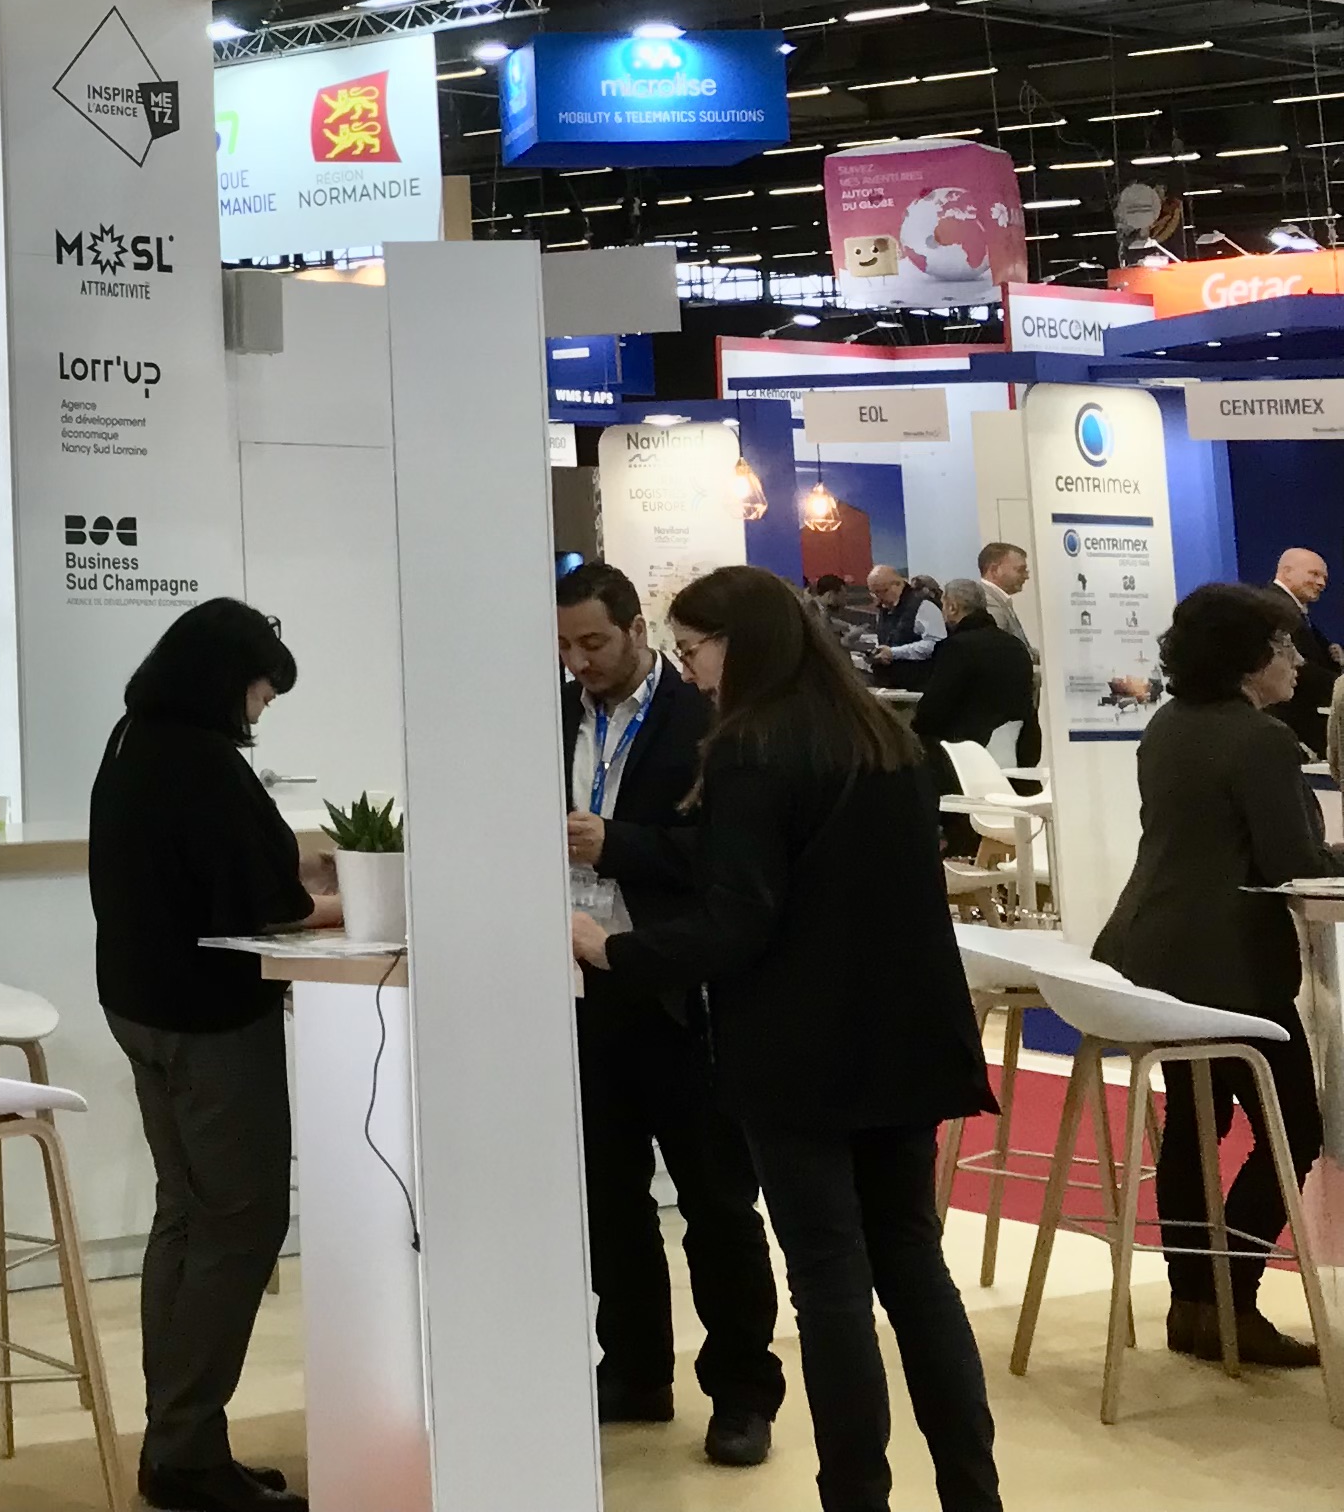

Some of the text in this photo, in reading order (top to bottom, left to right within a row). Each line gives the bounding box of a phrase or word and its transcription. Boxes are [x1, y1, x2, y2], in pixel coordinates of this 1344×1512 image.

[601, 72, 717, 97] microlise
[87, 84, 144, 105] INSPIRE
[87, 102, 138, 118] L'AGENCE
[559, 110, 764, 124] MOBILITY TELEMATICS SOLUTIONS
[316, 169, 364, 185] RÉGION
[298, 178, 421, 208] NORMANDIE
[842, 203, 856, 211] DU
[555, 389, 614, 405] WMS APS
[61, 399, 97, 412] Agence
[1220, 398, 1325, 416] CENTRIMEX
[61, 414, 146, 428] de développement
[859, 406, 888, 422] EOL
[61, 429, 119, 441] économique
[61, 443, 148, 456] Nancy Sud Lorraine
[65, 552, 139, 571] Business
[66, 573, 199, 596] Sud Champagne
